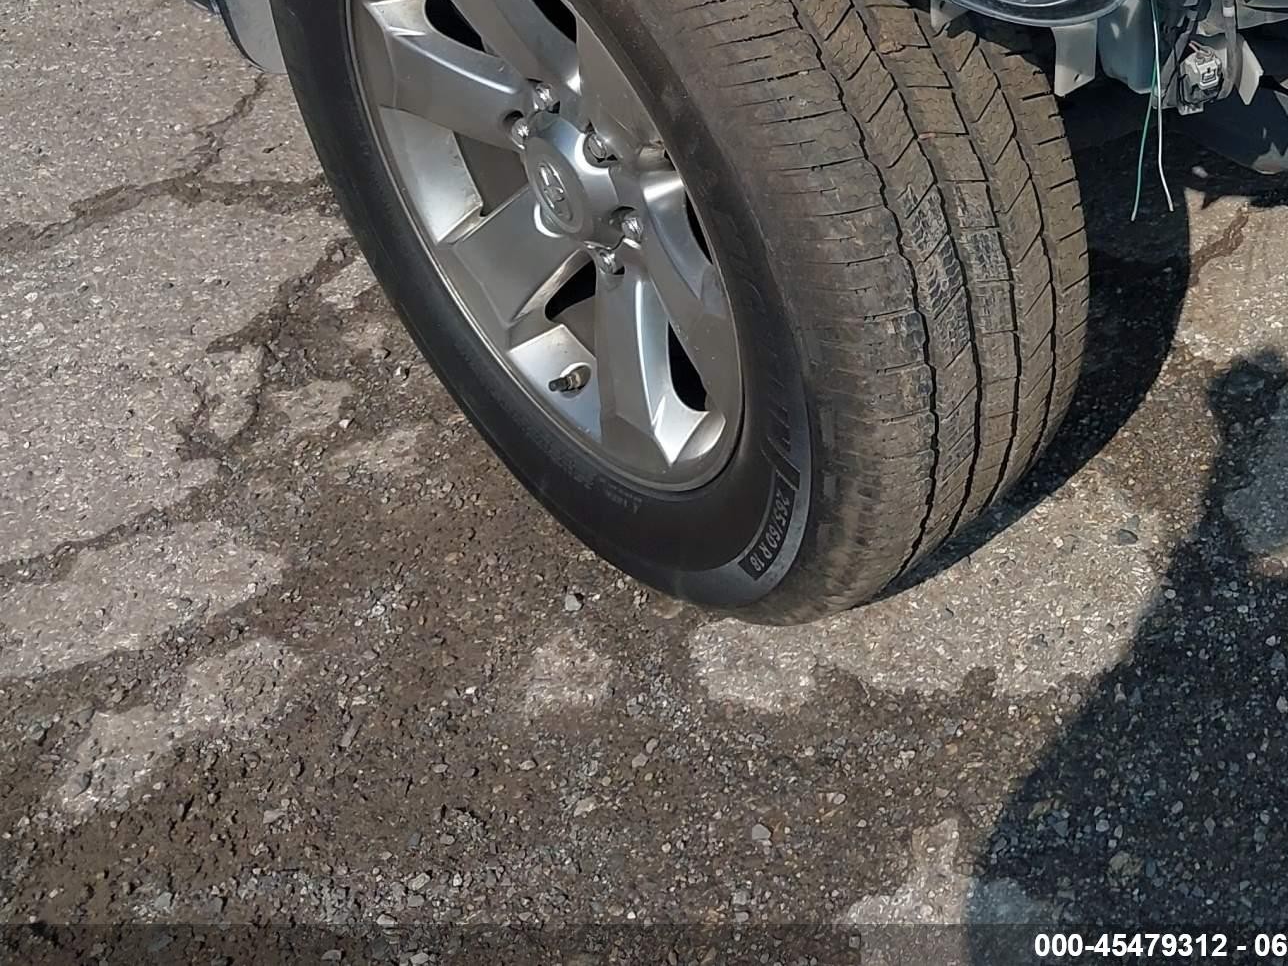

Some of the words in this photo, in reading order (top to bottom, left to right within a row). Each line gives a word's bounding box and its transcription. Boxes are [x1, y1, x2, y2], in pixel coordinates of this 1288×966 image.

[766, 489, 790, 549] 265/60
[759, 541, 773, 560] R
[750, 553, 765, 572] 18
